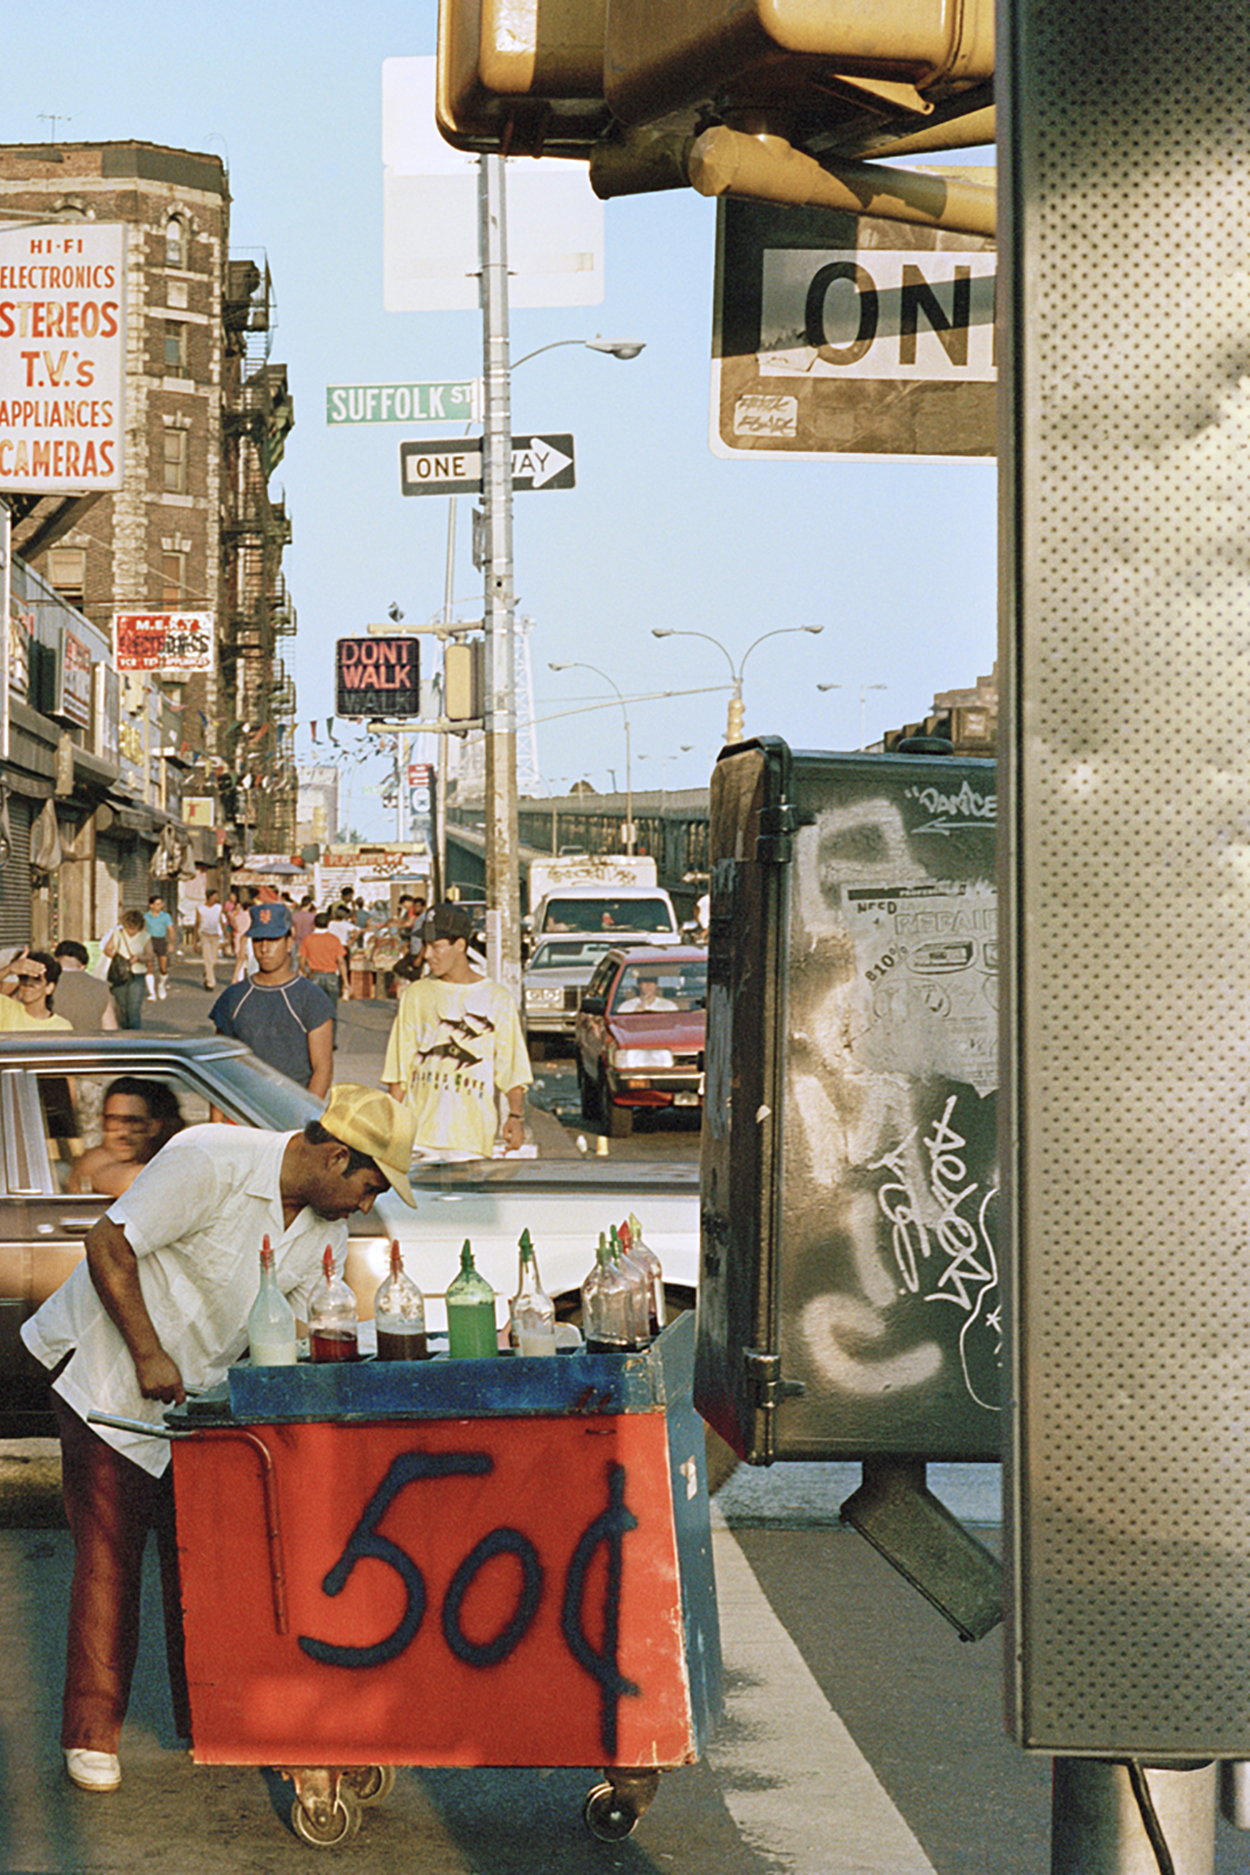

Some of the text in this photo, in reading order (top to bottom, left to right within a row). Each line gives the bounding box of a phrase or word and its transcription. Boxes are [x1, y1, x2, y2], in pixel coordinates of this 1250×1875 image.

[0, 265, 115, 289] ELECTRONICS
[805, 261, 997, 367] ON
[331, 385, 472, 421] SUFFOLK ST
[416, 455, 466, 478] ONE
[341, 641, 412, 664] DONT
[342, 665, 411, 689] WALK
[298, 1452, 639, 1757] 50¢
